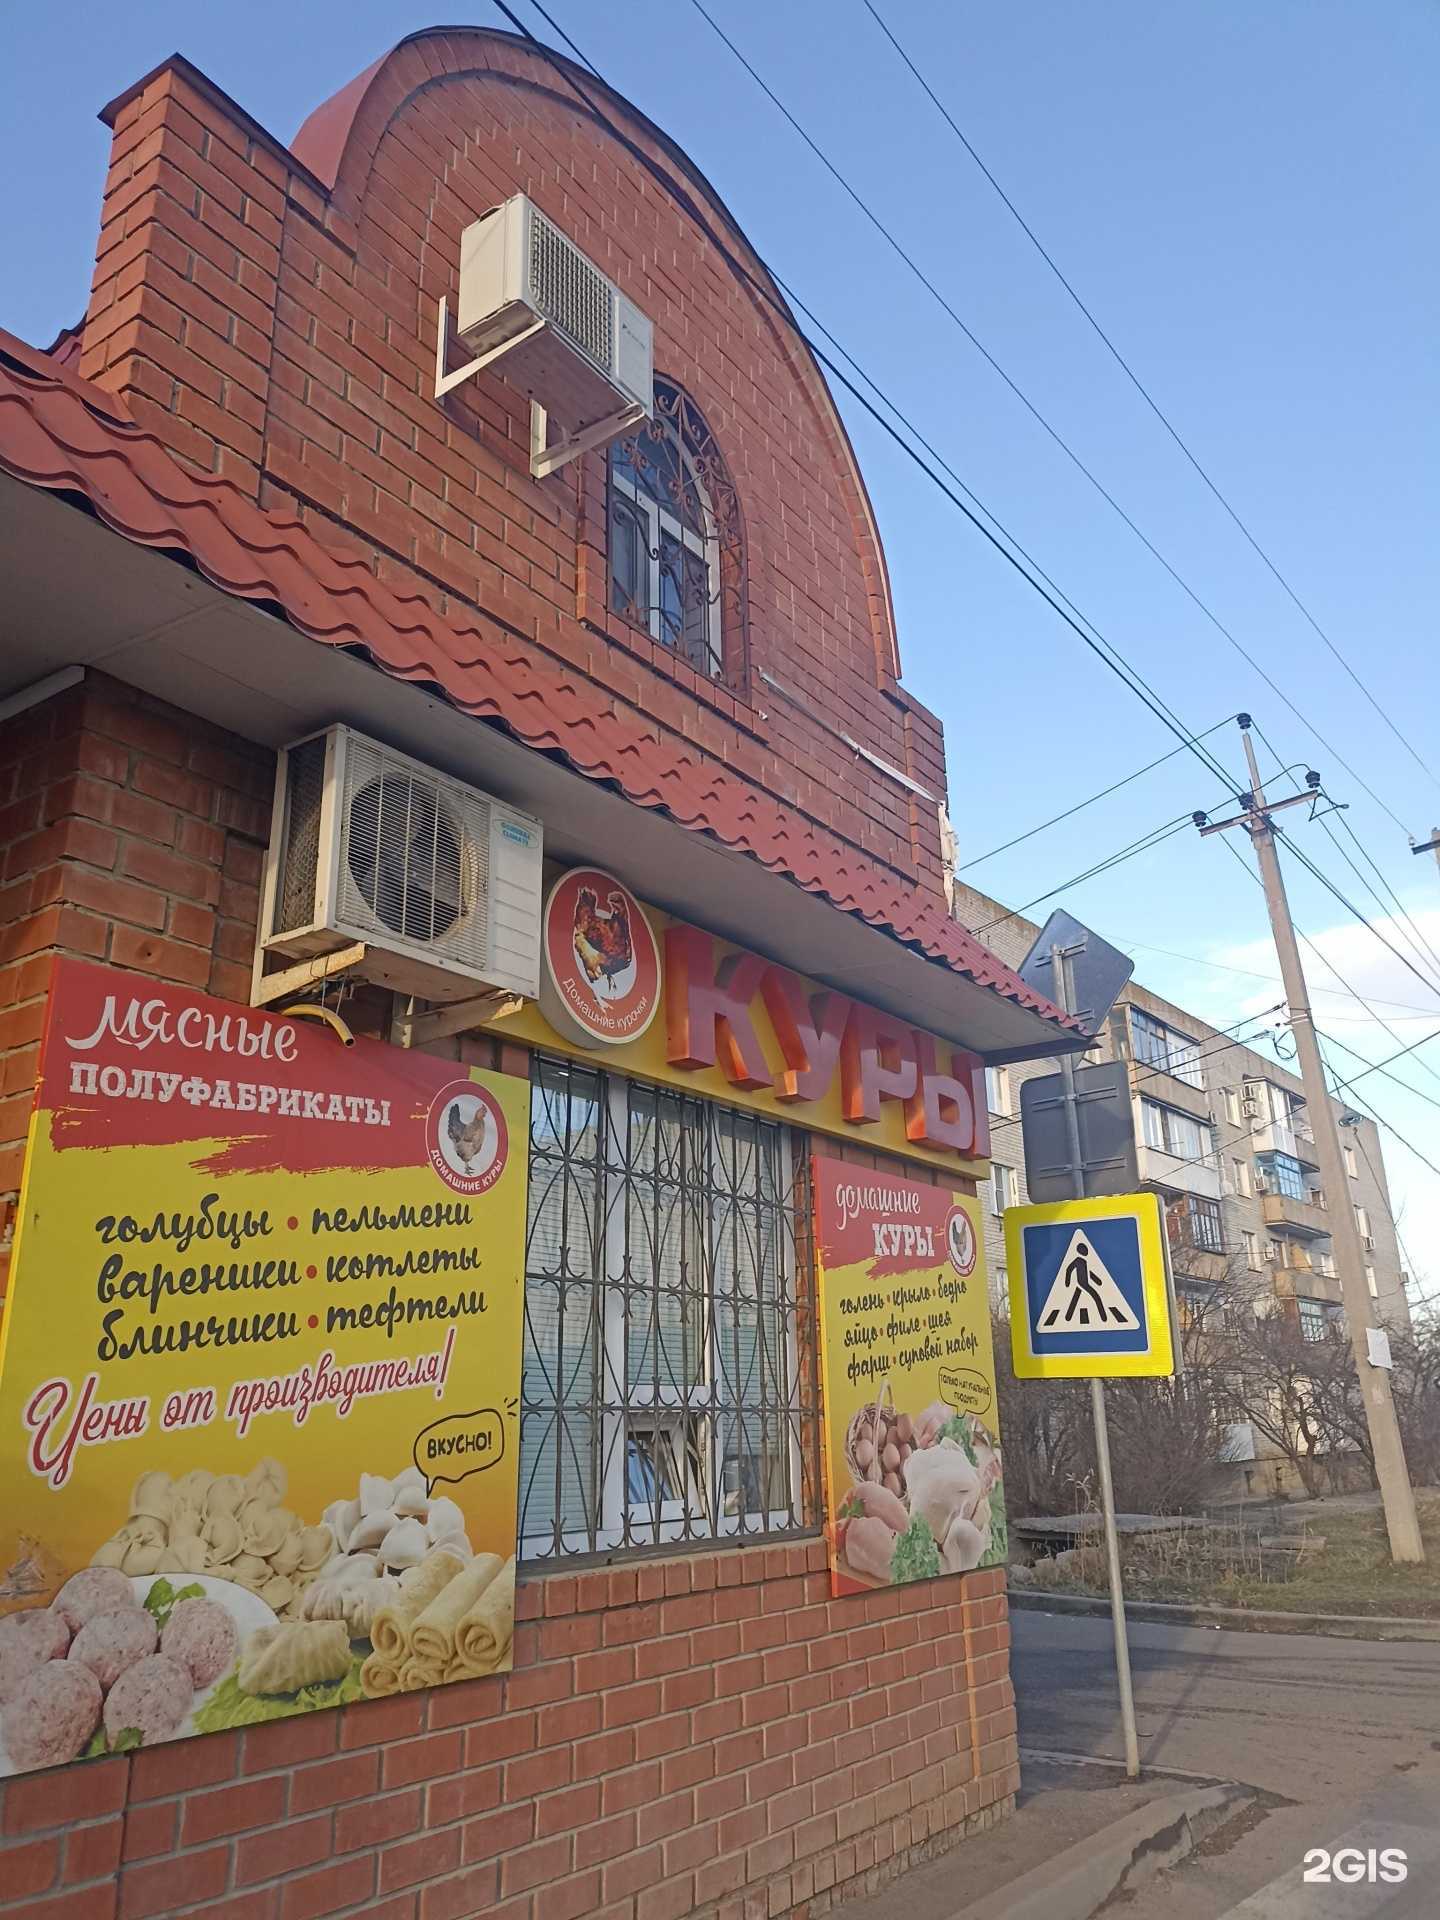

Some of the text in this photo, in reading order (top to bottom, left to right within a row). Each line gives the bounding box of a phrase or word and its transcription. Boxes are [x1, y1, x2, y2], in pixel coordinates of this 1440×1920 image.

[562, 978, 648, 1030] Домашние курочки
[664, 924, 993, 1160] КУРЫ
[69, 1061, 391, 1126] ПОЛУФАБРИКАТЫ
[430, 1149, 503, 1191] ДОМАШНИЕ КУРЫ
[95, 1193, 473, 1253] голубцы пельмени
[872, 1223, 935, 1257] КУРЫ
[98, 1247, 482, 1314] вареники котлеты
[840, 1274, 968, 1315] голень крыло бедро
[97, 1287, 488, 1362] блинчики тефтели
[844, 1310, 953, 1349] яйцо филе шея
[848, 1326, 979, 1386] фарш суповой набор
[26, 1328, 455, 1486] Цены от производителя!
[427, 1430, 492, 1459] ВКУСНО!
